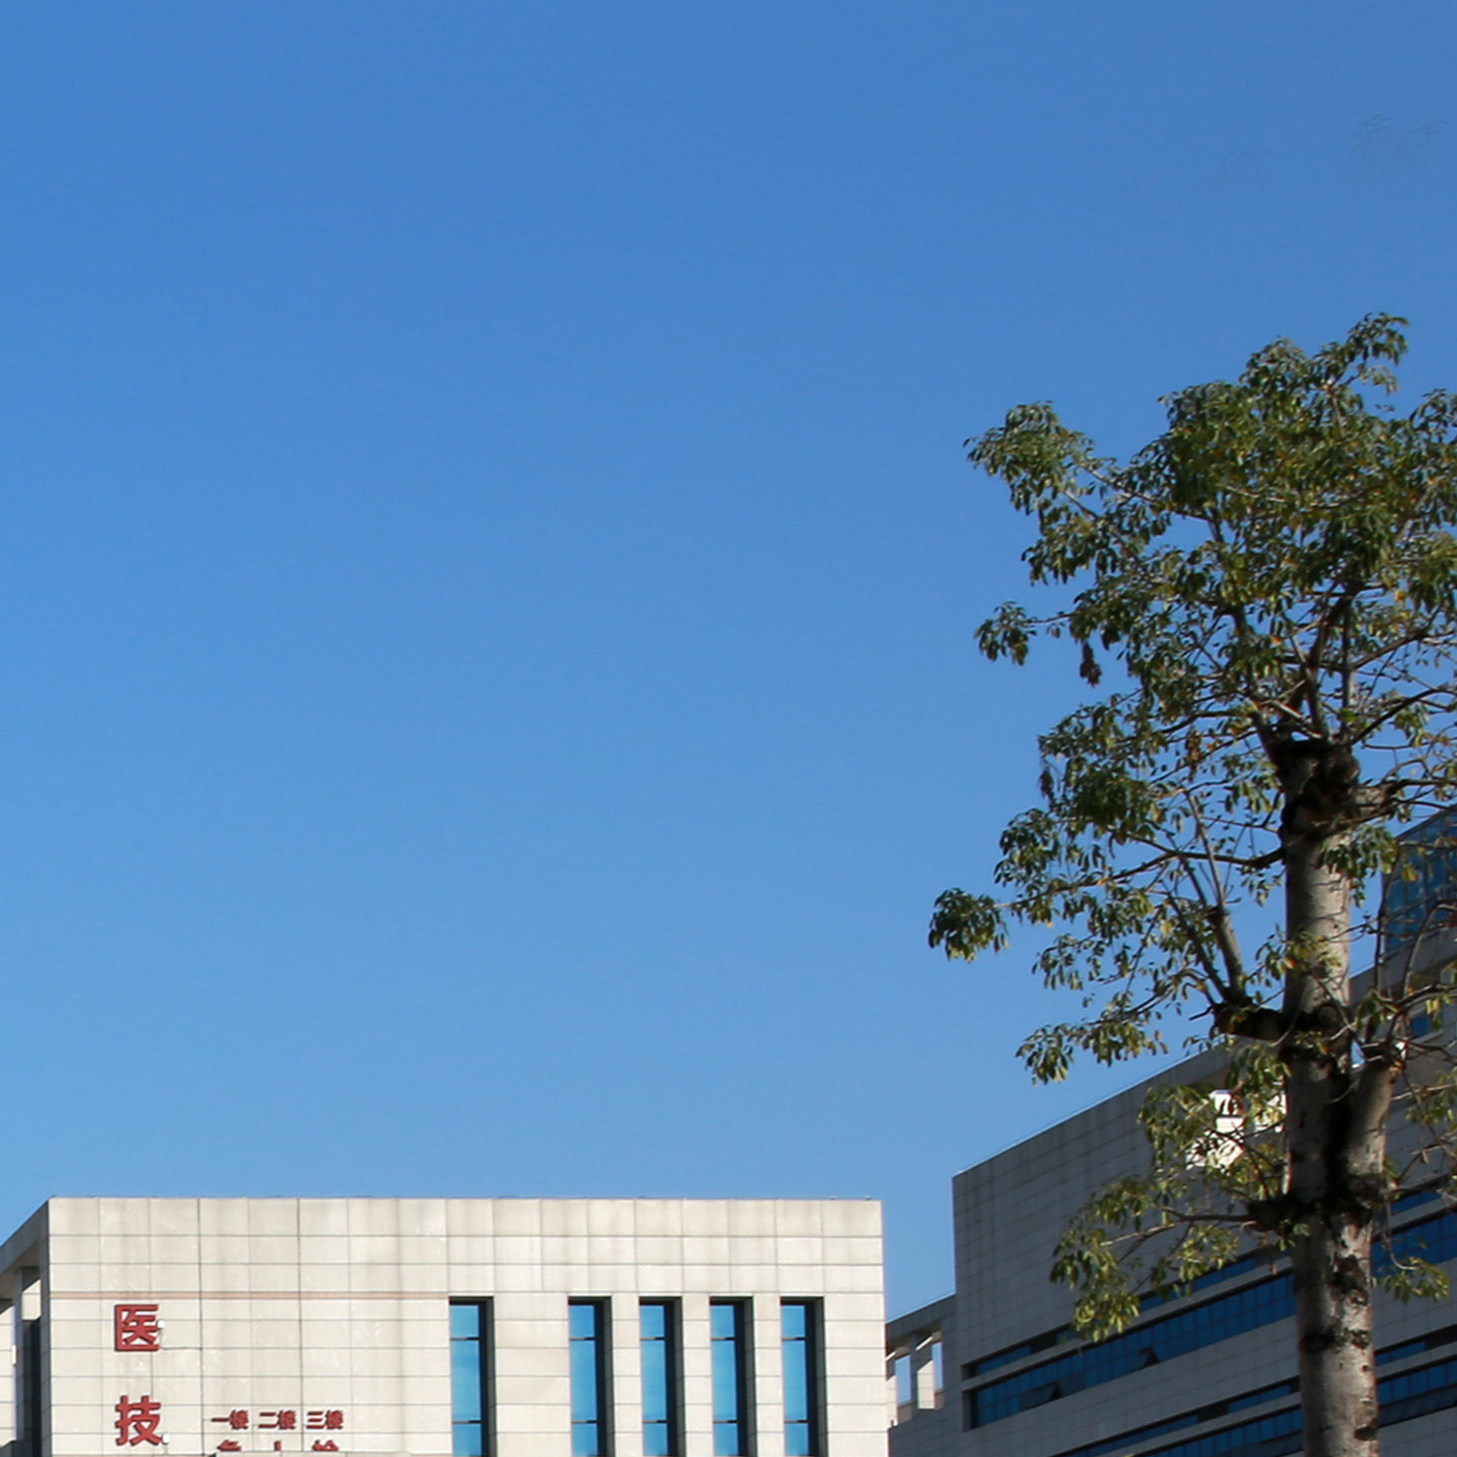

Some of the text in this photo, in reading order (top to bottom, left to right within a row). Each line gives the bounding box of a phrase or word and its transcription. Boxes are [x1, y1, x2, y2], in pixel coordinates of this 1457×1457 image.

[211, 1409, 343, 1430] 一楼 二楼 三楼
